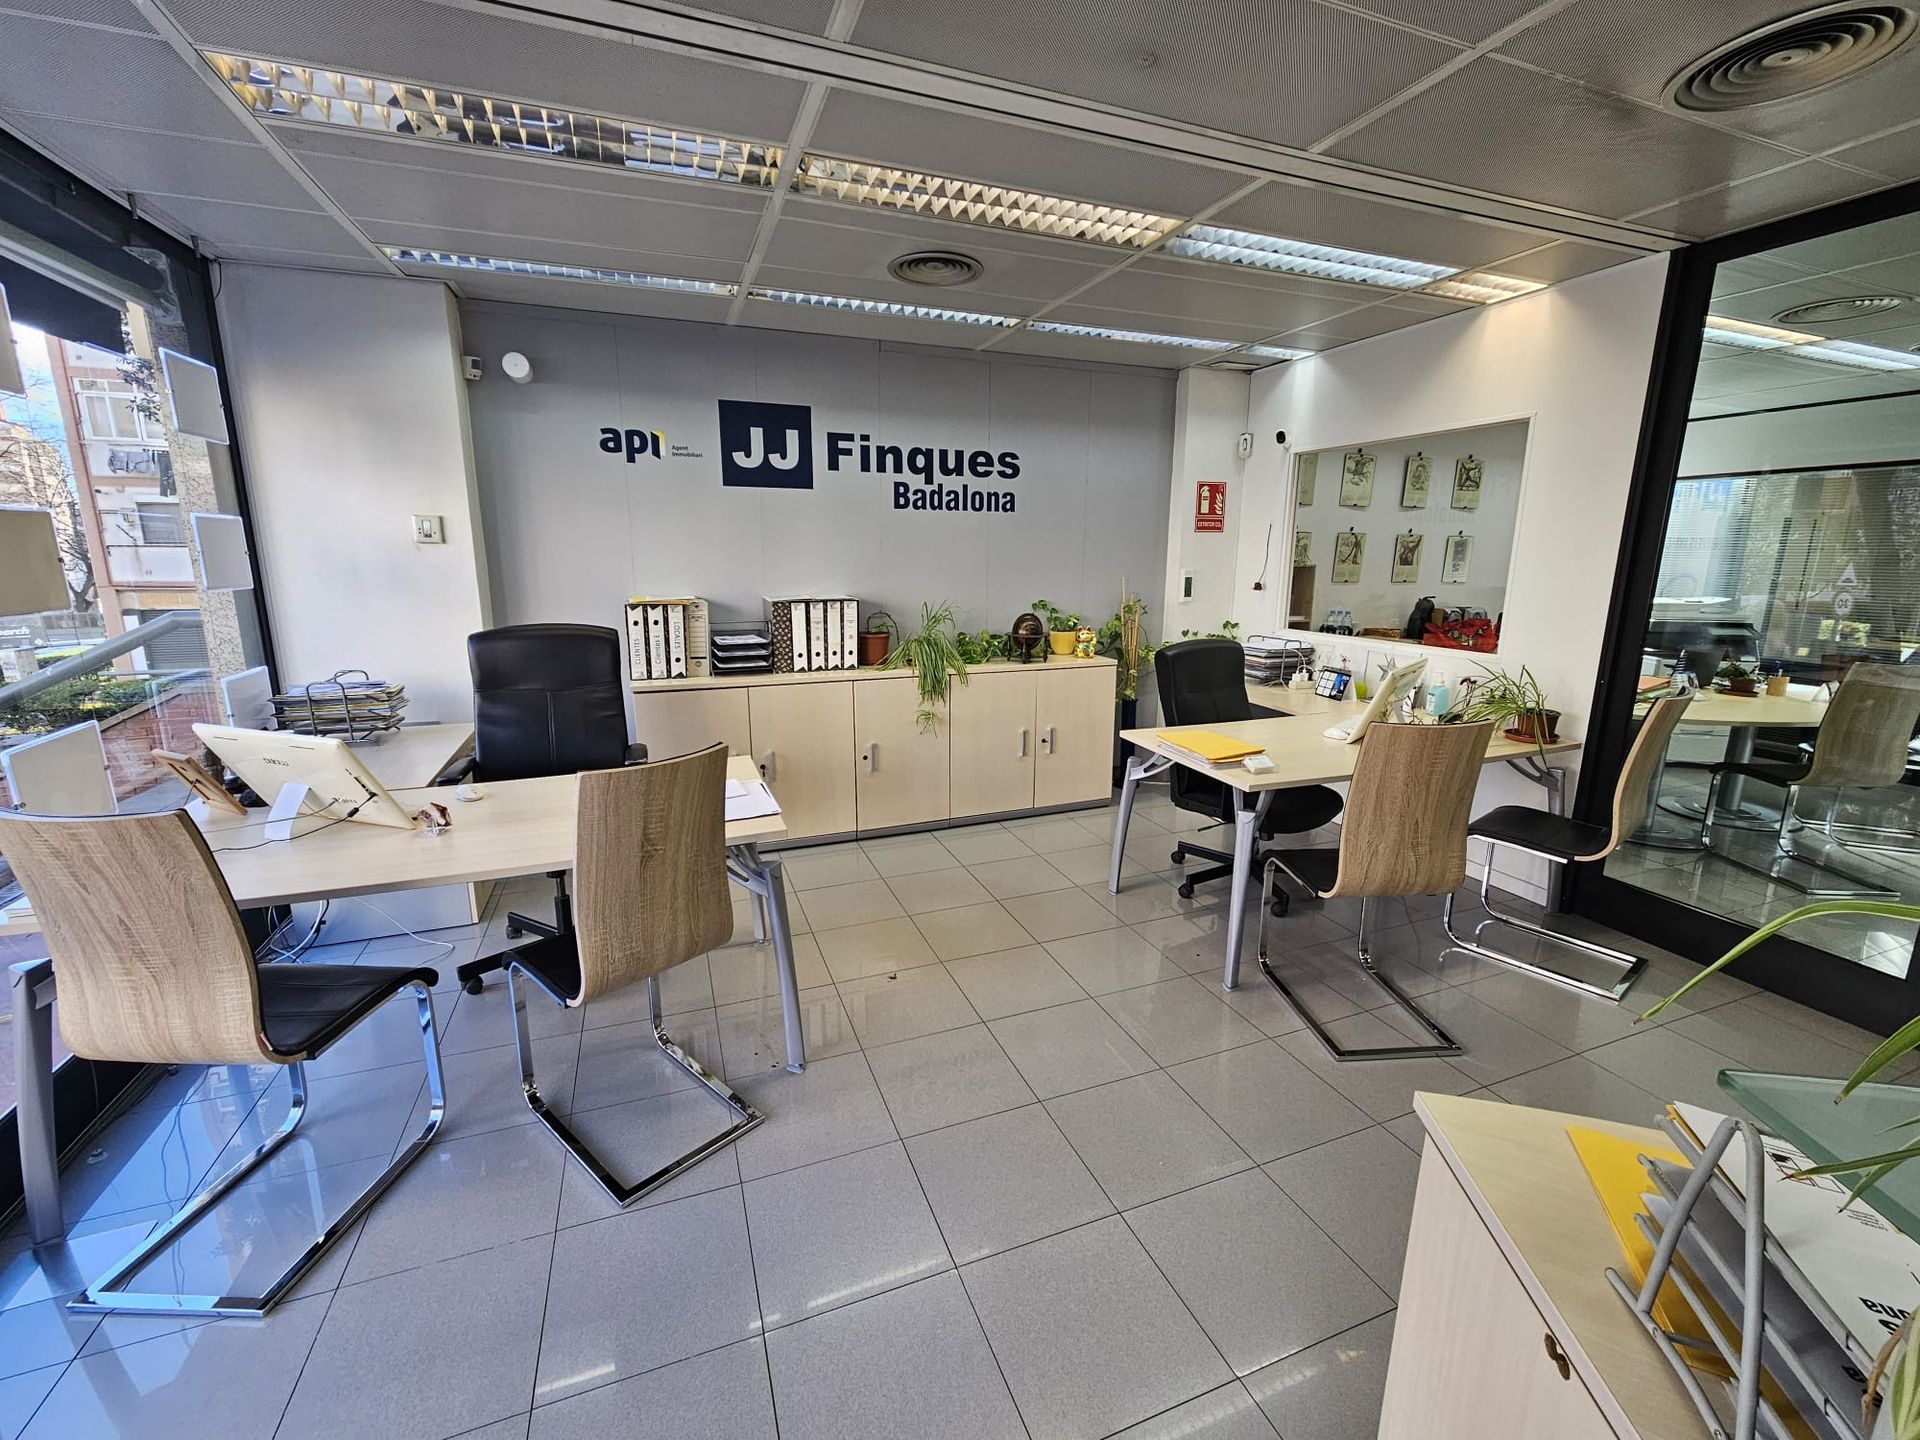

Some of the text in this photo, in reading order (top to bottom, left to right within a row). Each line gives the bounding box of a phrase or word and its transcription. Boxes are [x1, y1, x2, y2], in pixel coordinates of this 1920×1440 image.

[599, 427, 666, 463] api
[732, 426, 800, 470] JJ
[826, 431, 1021, 485] Finques
[893, 481, 1016, 513] Badalona
[633, 638, 641, 665] CLIENTES
[673, 621, 681, 649] LOCALES
